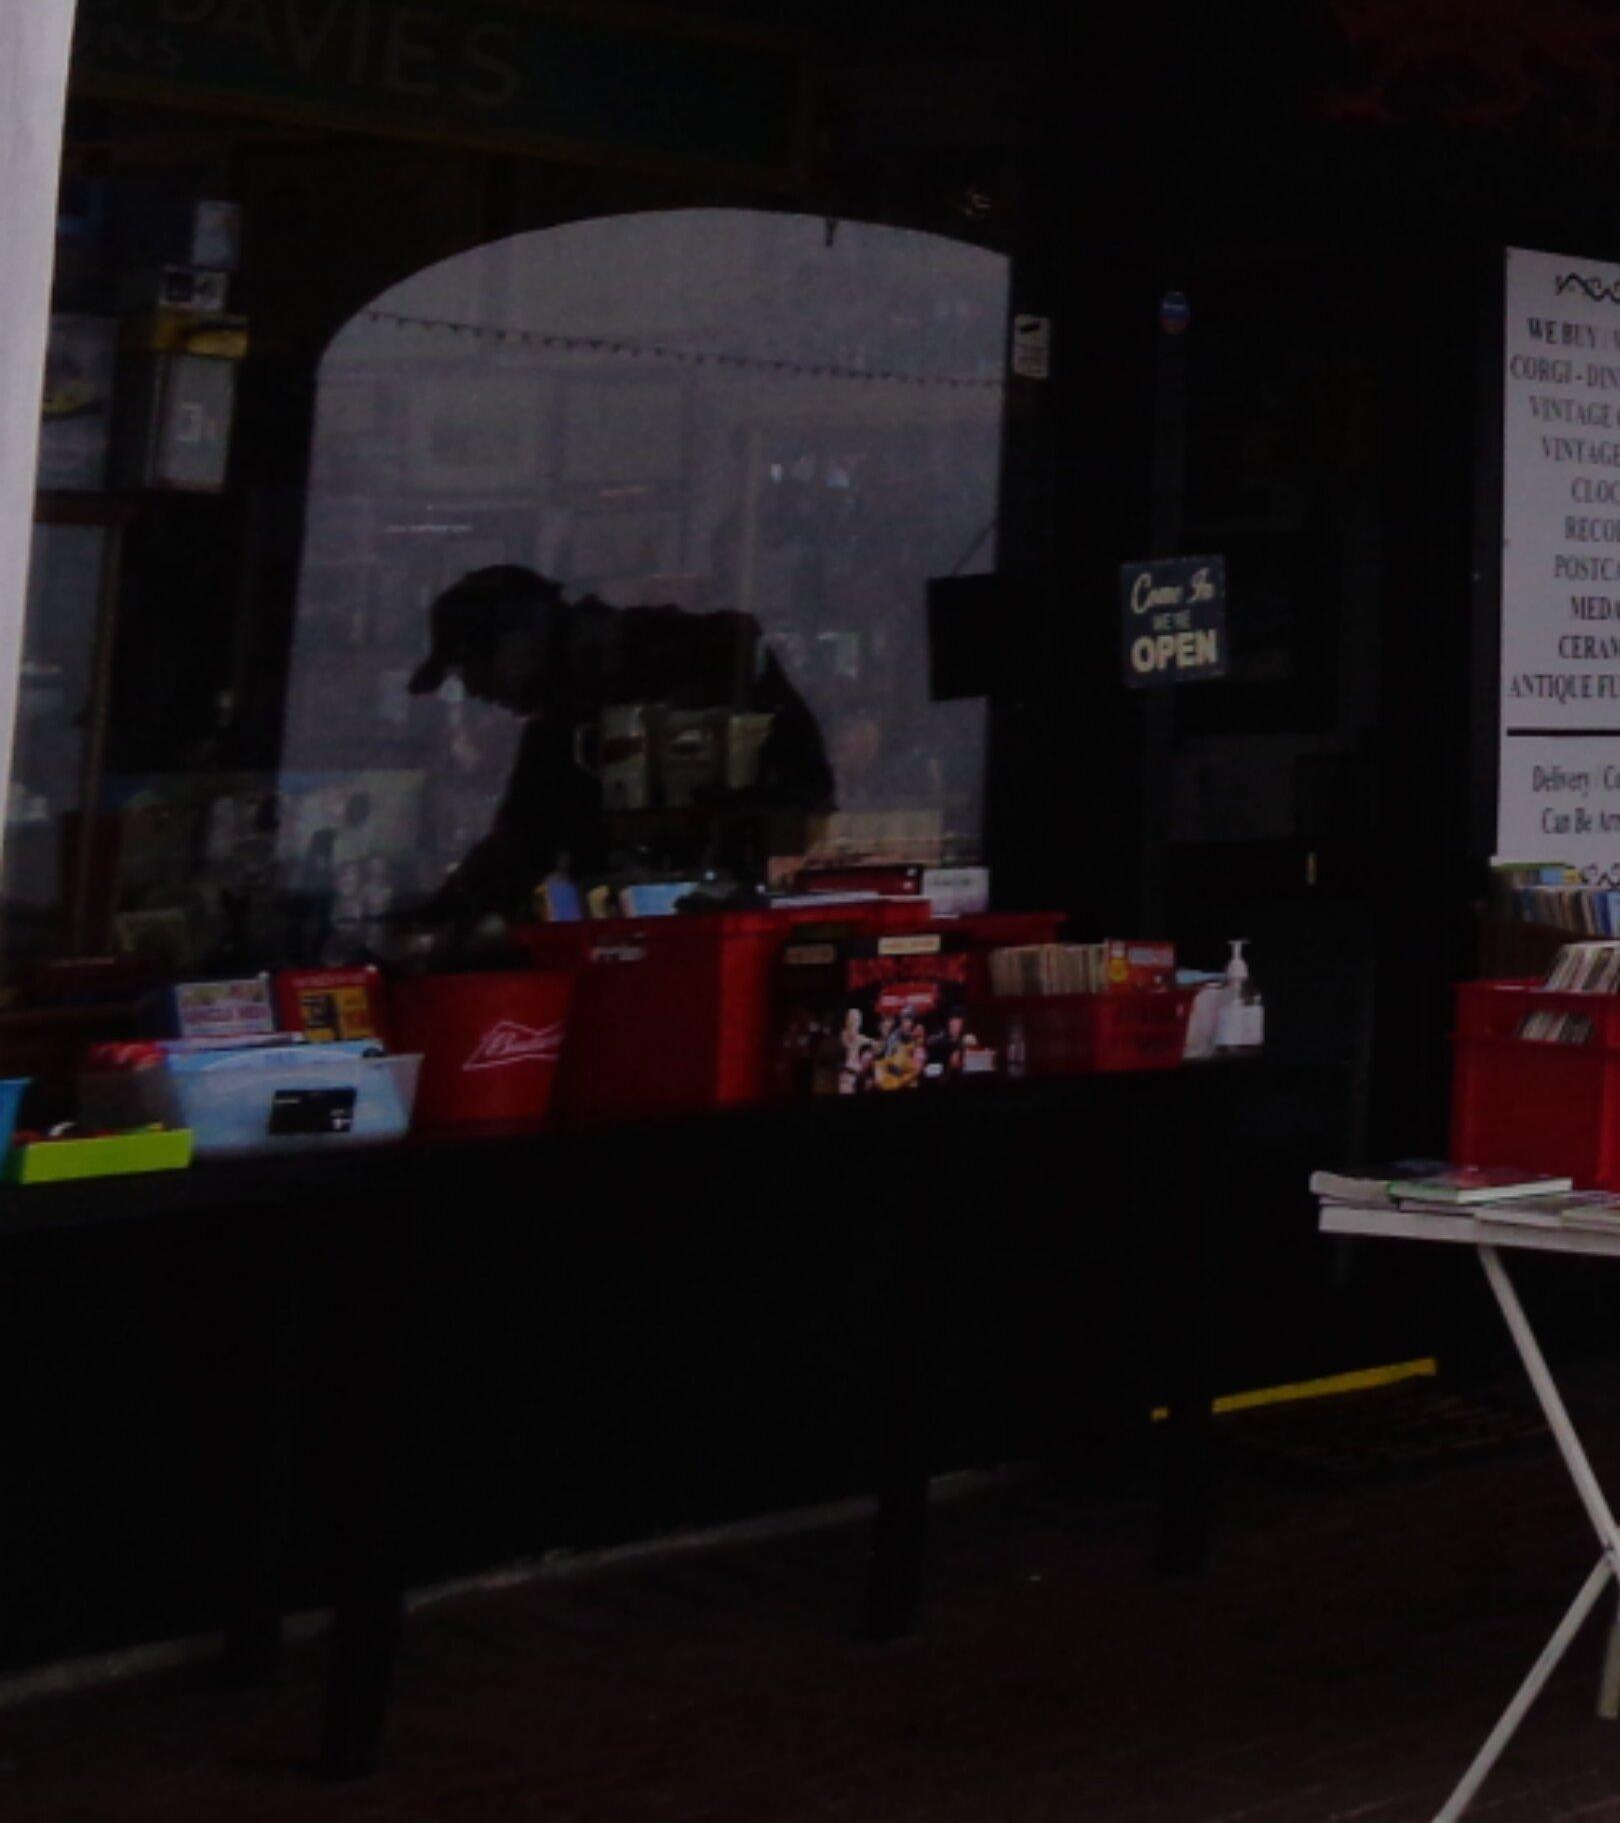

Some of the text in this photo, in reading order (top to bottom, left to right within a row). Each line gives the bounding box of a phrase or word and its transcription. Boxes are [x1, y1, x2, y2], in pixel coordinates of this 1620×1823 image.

[1527, 316, 1557, 345] WE
[1561, 321, 1596, 349] BUY
[1510, 354, 1572, 383] CORGI
[1529, 395, 1612, 428] VINTAGE
[1131, 629, 1218, 673] OPEN
[1510, 673, 1592, 704] ANTIQUE
[1532, 764, 1590, 798] Delivery
[1542, 806, 1570, 834] Can
[1574, 806, 1592, 834] Be
